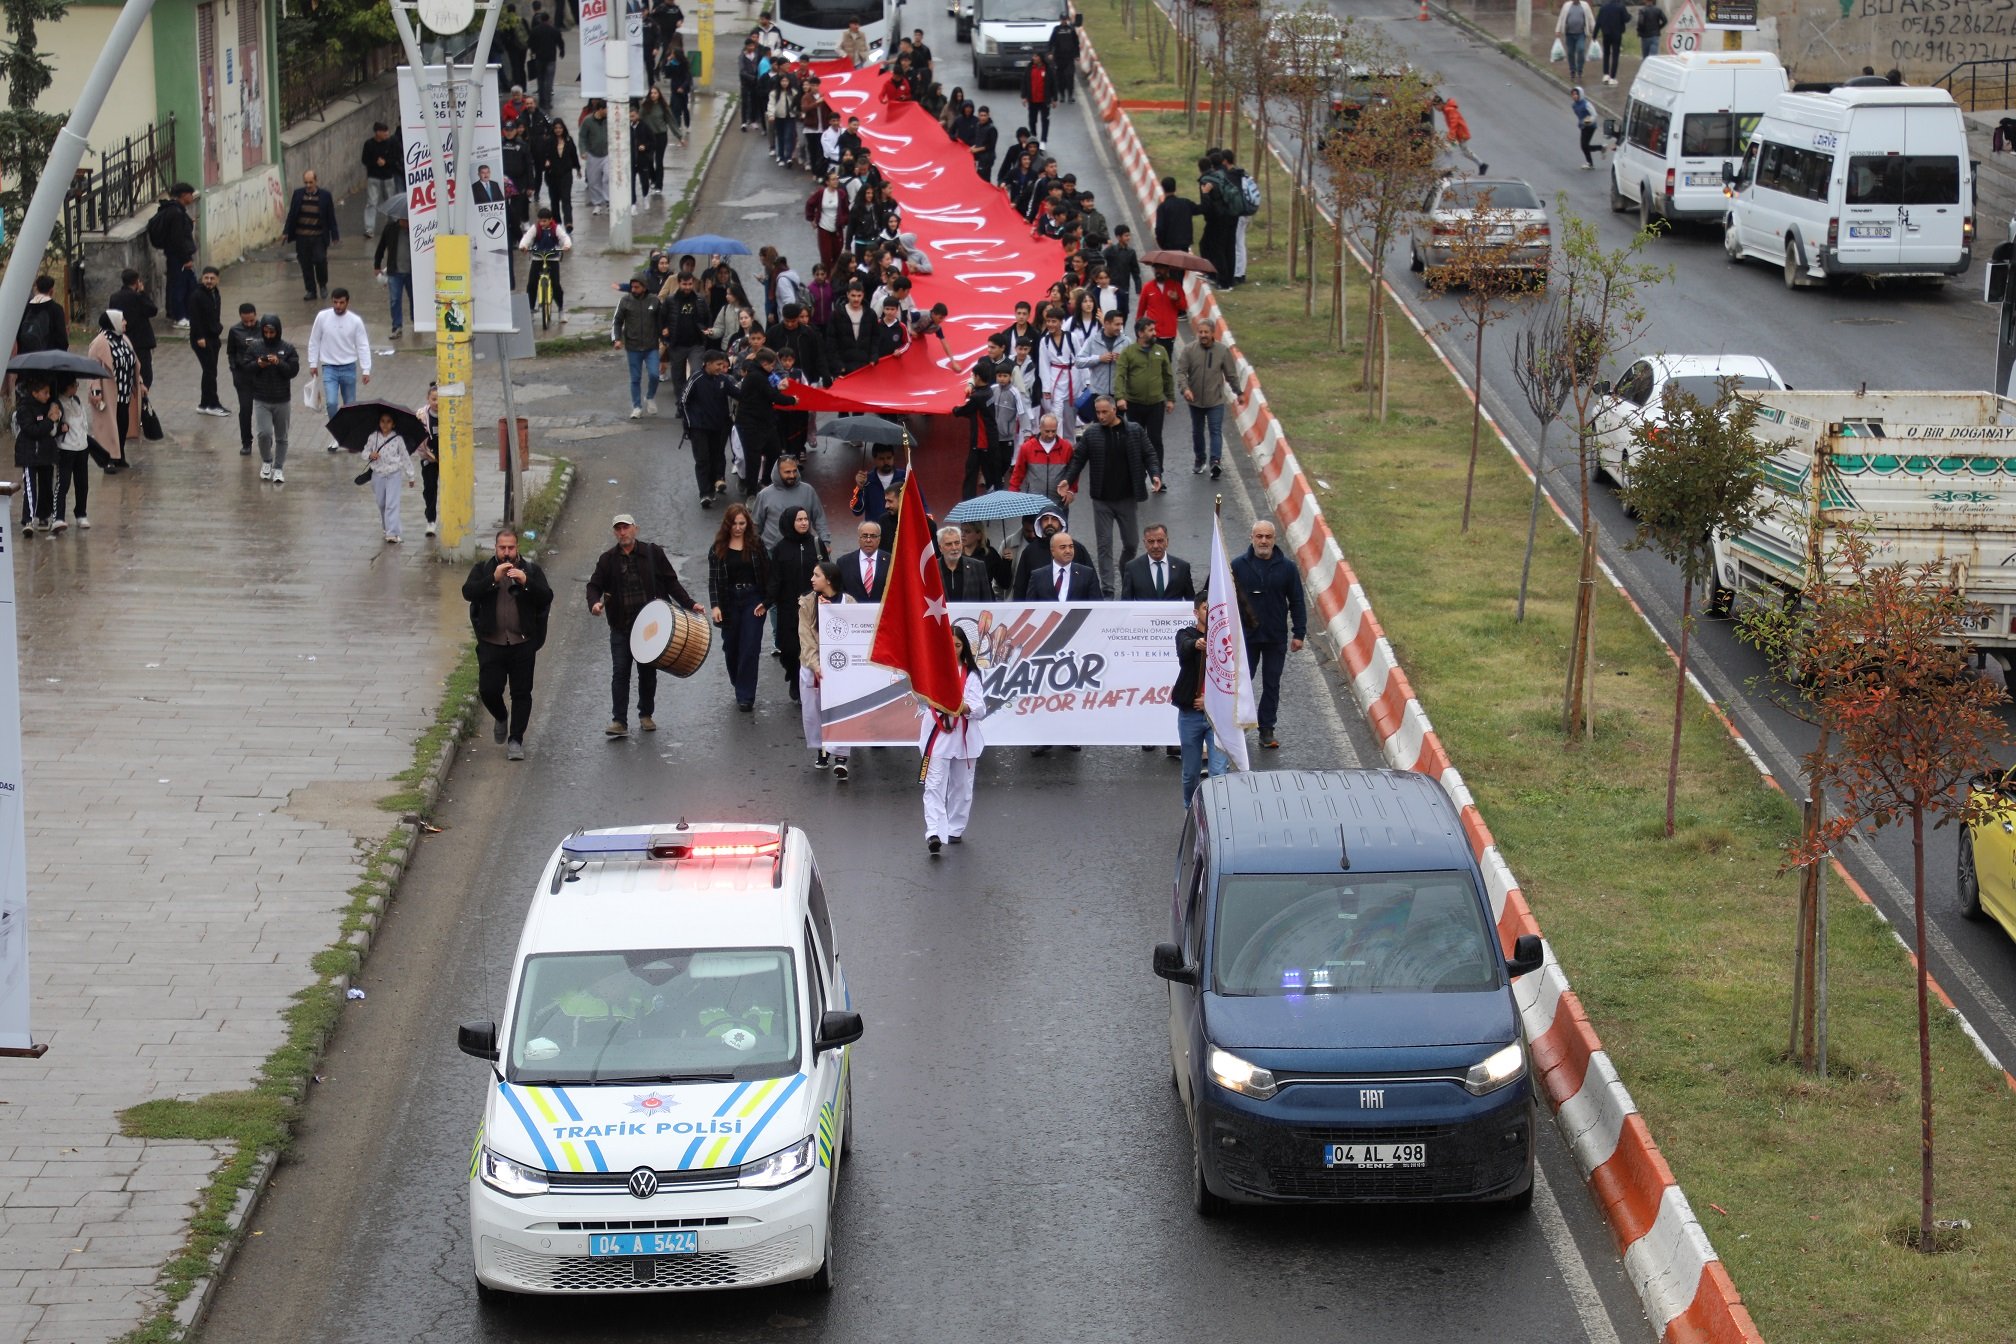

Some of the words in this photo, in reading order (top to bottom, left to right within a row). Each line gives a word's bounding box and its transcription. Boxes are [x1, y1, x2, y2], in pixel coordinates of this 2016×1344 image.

[1673, 34, 1694, 51] 30
[478, 203, 504, 213] BEYAZ
[983, 650, 1105, 698] MATÖR
[1016, 691, 1076, 716] SPOR
[1360, 1090, 1385, 1108] FIAT
[553, 1121, 646, 1139] TRAFİK
[656, 1120, 742, 1134] POLİSİ
[1334, 1146, 1354, 1162] 04
[1364, 1146, 1384, 1162] AL
[1392, 1146, 1423, 1162] 498
[600, 1236, 620, 1254] 04
[632, 1236, 644, 1252] A
[654, 1234, 696, 1252] 5424
